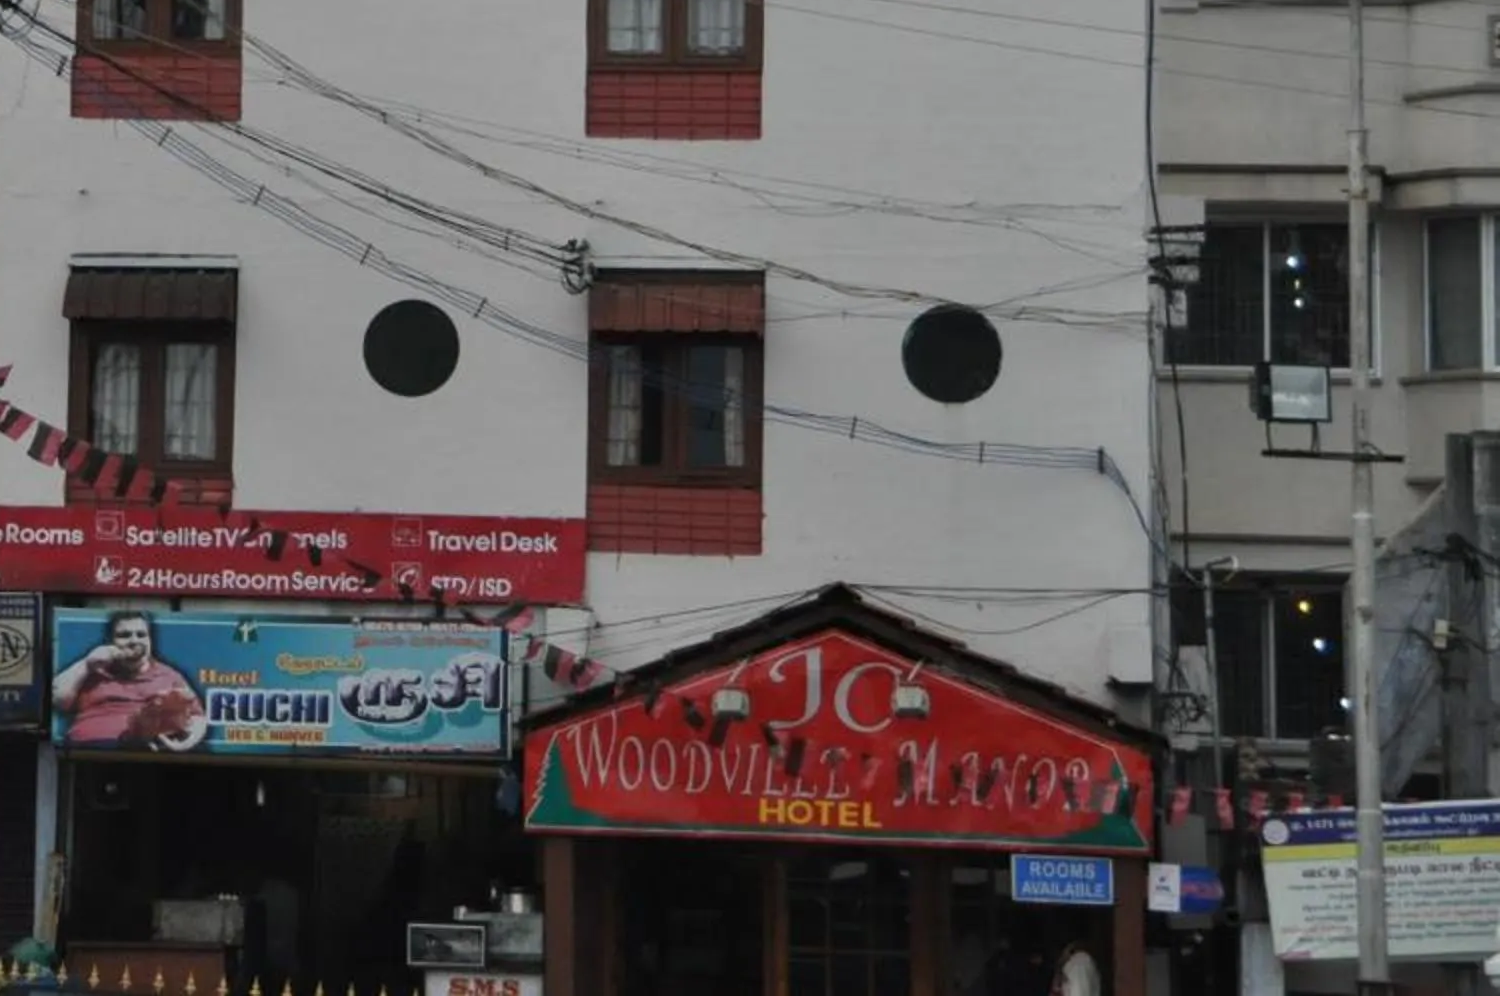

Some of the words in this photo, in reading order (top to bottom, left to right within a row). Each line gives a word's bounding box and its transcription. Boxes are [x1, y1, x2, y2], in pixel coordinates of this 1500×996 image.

[6, 523, 85, 545] Rooms
[428, 530, 497, 553] Travel
[500, 531, 559, 553] Desk
[200, 668, 258, 685] Hotel
[768, 645, 901, 733] JC
[209, 692, 329, 724] RUCHI
[758, 797, 883, 828] HOTEL
[1029, 860, 1096, 879] ROOMS
[1021, 881, 1105, 899] AVAILABLE
